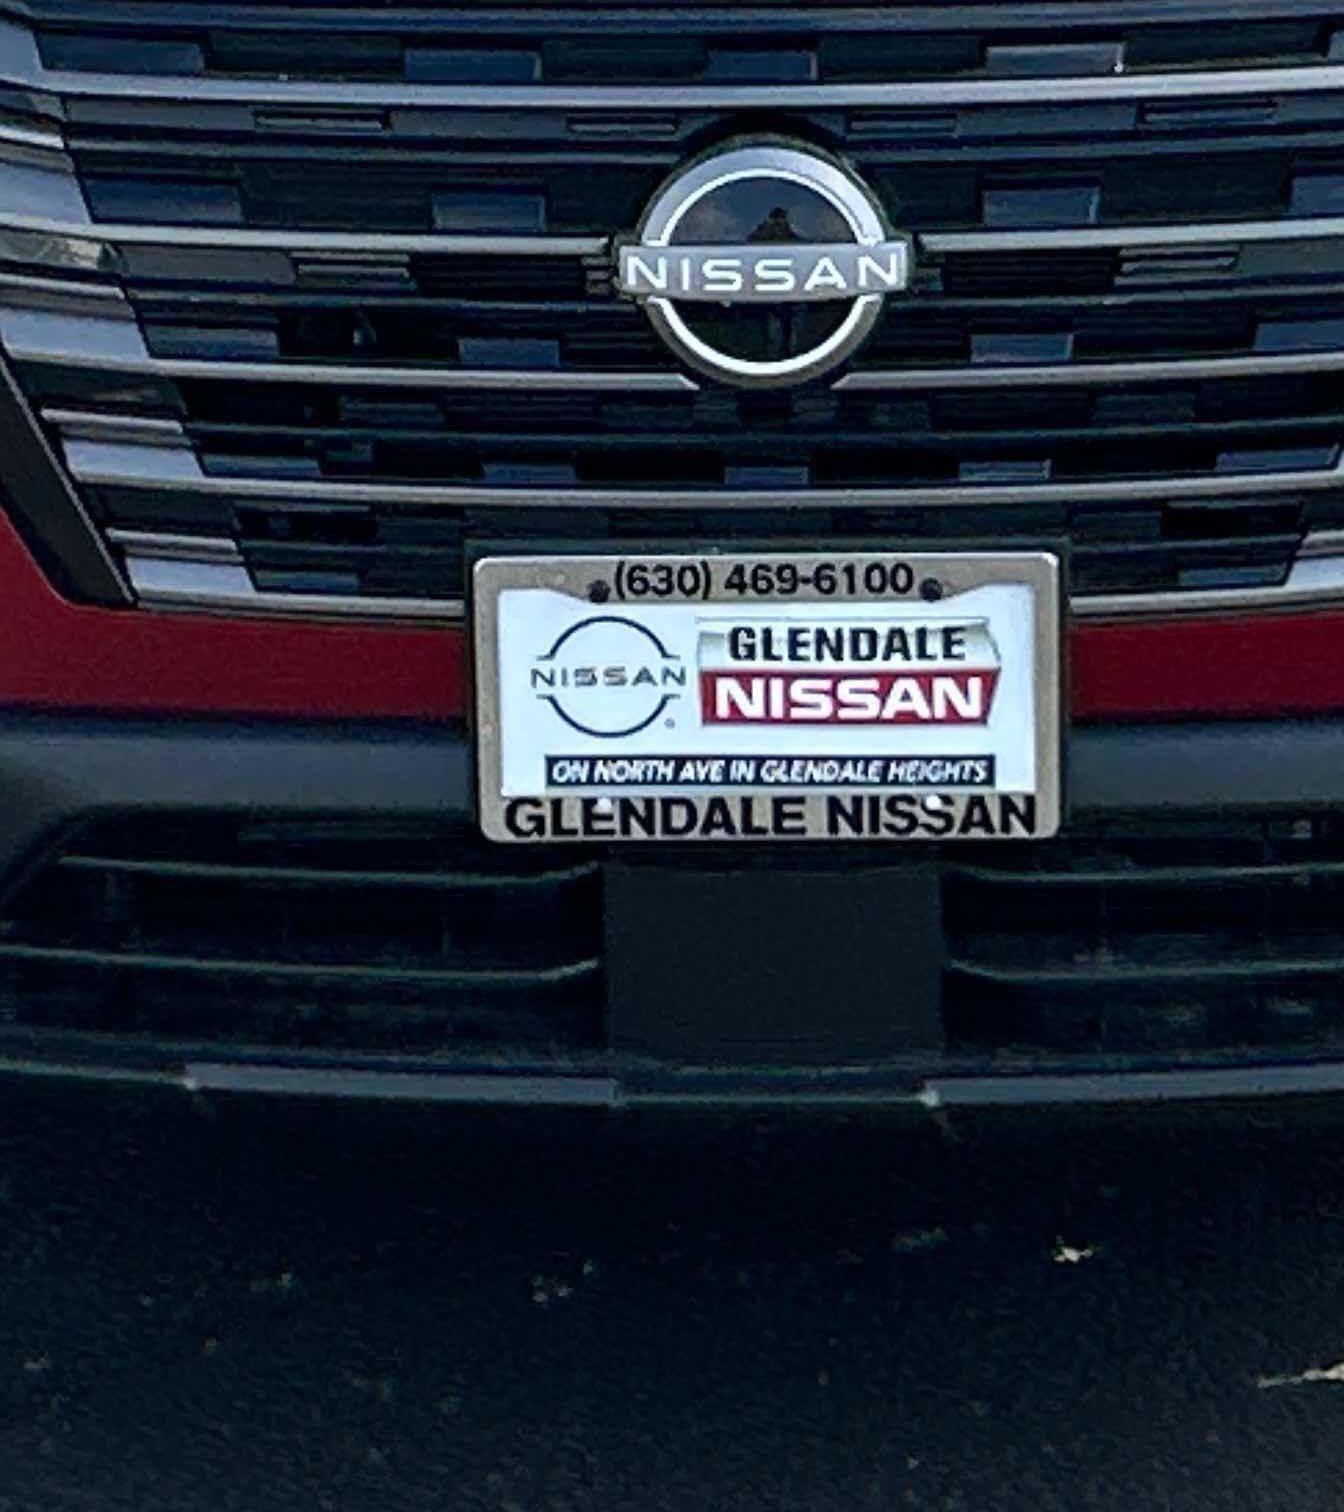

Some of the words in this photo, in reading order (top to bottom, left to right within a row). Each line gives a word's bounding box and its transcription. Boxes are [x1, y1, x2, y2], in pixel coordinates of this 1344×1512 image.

[626, 255, 898, 292] NISSAN
[614, 561, 712, 601] (630)
[724, 562, 914, 596] 469-6100
[729, 625, 968, 662] GLENDALE
[531, 667, 687, 689] NISSAN
[715, 675, 986, 720] NISSAN
[551, 760, 590, 784] ON
[594, 759, 674, 783] NORTH
[679, 759, 725, 783] AVE
[730, 759, 755, 783] IN
[761, 759, 882, 785] GLENDALE
[888, 759, 989, 784] HEIGHTS
[504, 796, 807, 838] GLENDALE
[825, 795, 1038, 836] NISSAN
